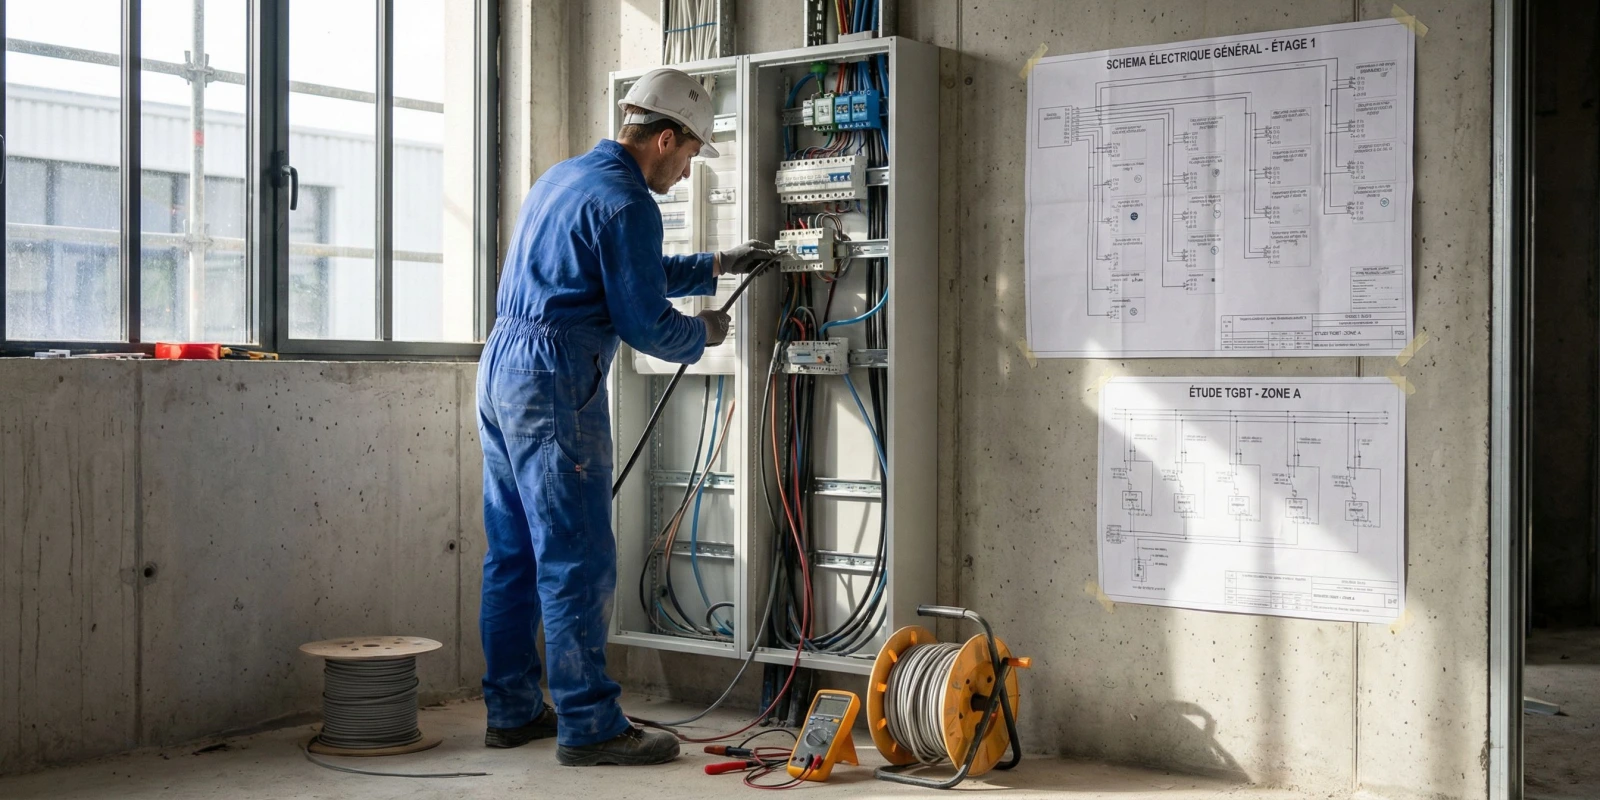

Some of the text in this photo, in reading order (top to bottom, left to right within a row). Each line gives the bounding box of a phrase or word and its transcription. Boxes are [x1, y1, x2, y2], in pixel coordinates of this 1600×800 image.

[1106, 56, 1147, 70] SCHEMA
[1149, 48, 1211, 66] ÉLECTRIQUE
[1213, 43, 1263, 59] GÉNÉRAL
[1271, 39, 1308, 53] ÉTAGE
[1310, 37, 1316, 48] 1
[1189, 385, 1222, 398] ÉTUDE
[1225, 387, 1253, 398] TGBT
[1261, 387, 1291, 399] ZONE
[1293, 388, 1301, 399] A
